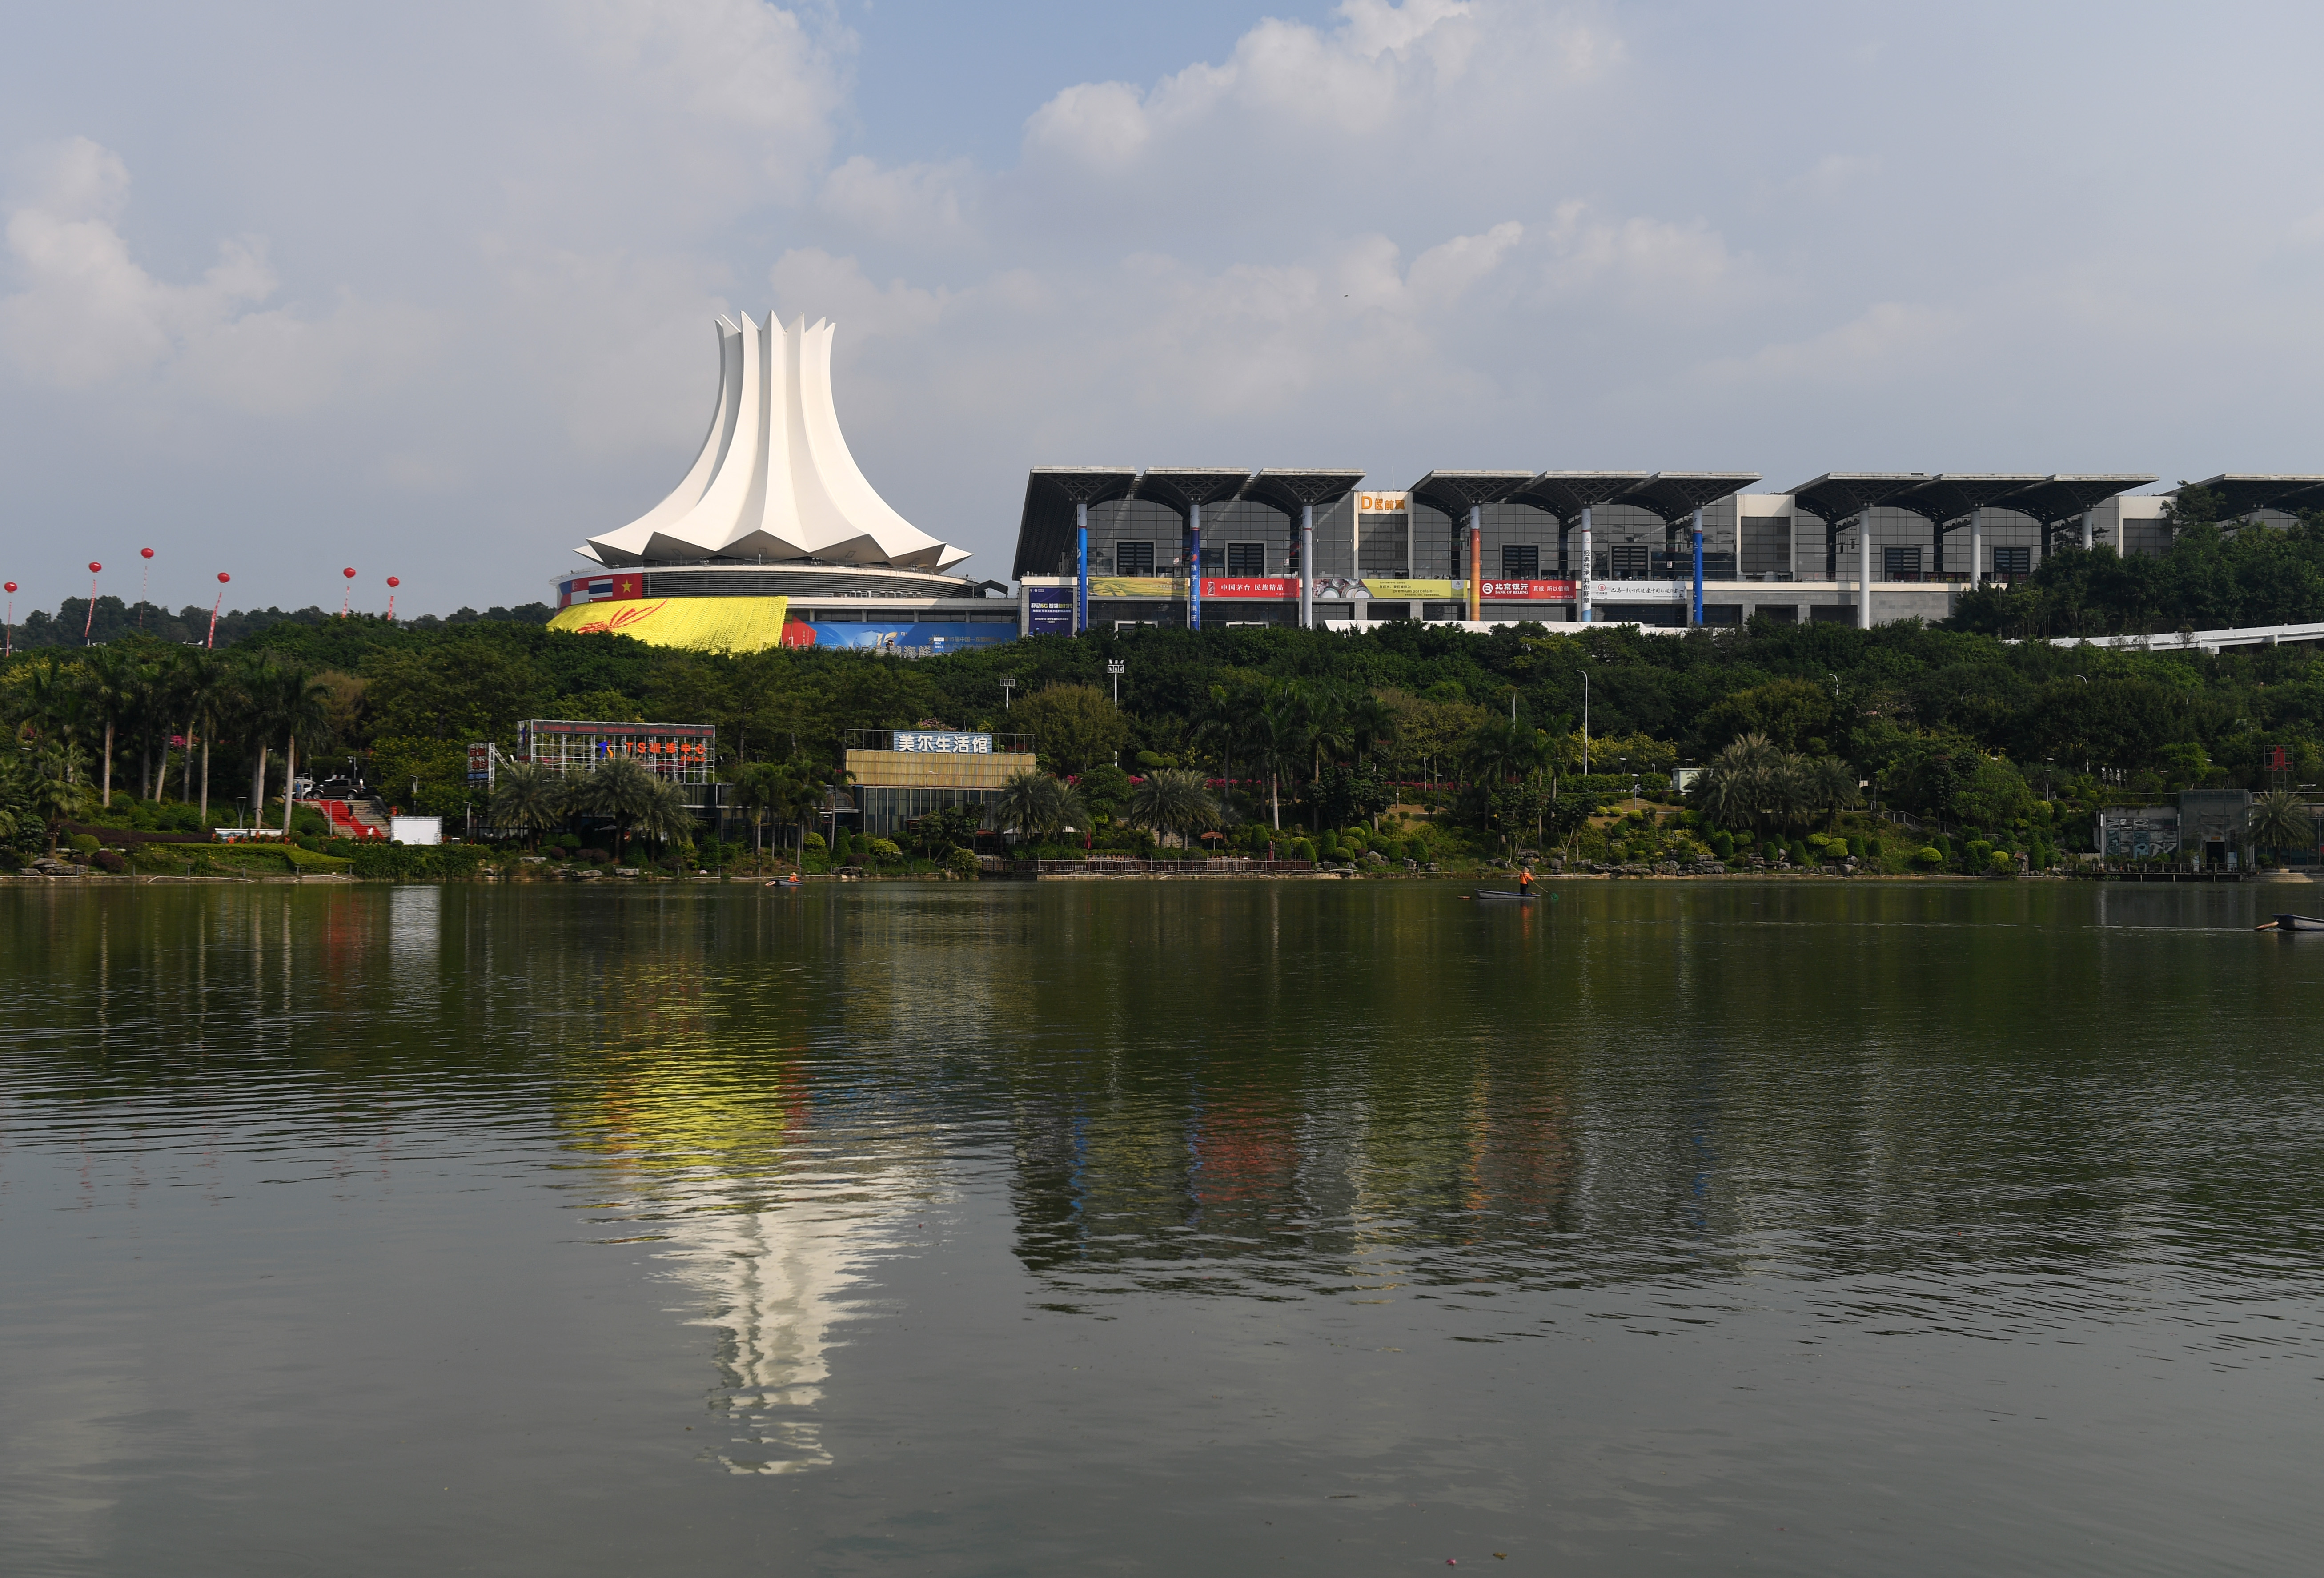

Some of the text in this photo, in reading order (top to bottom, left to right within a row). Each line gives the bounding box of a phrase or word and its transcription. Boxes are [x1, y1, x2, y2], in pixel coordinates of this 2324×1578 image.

[899, 734, 988, 753] 美尔生活馆
